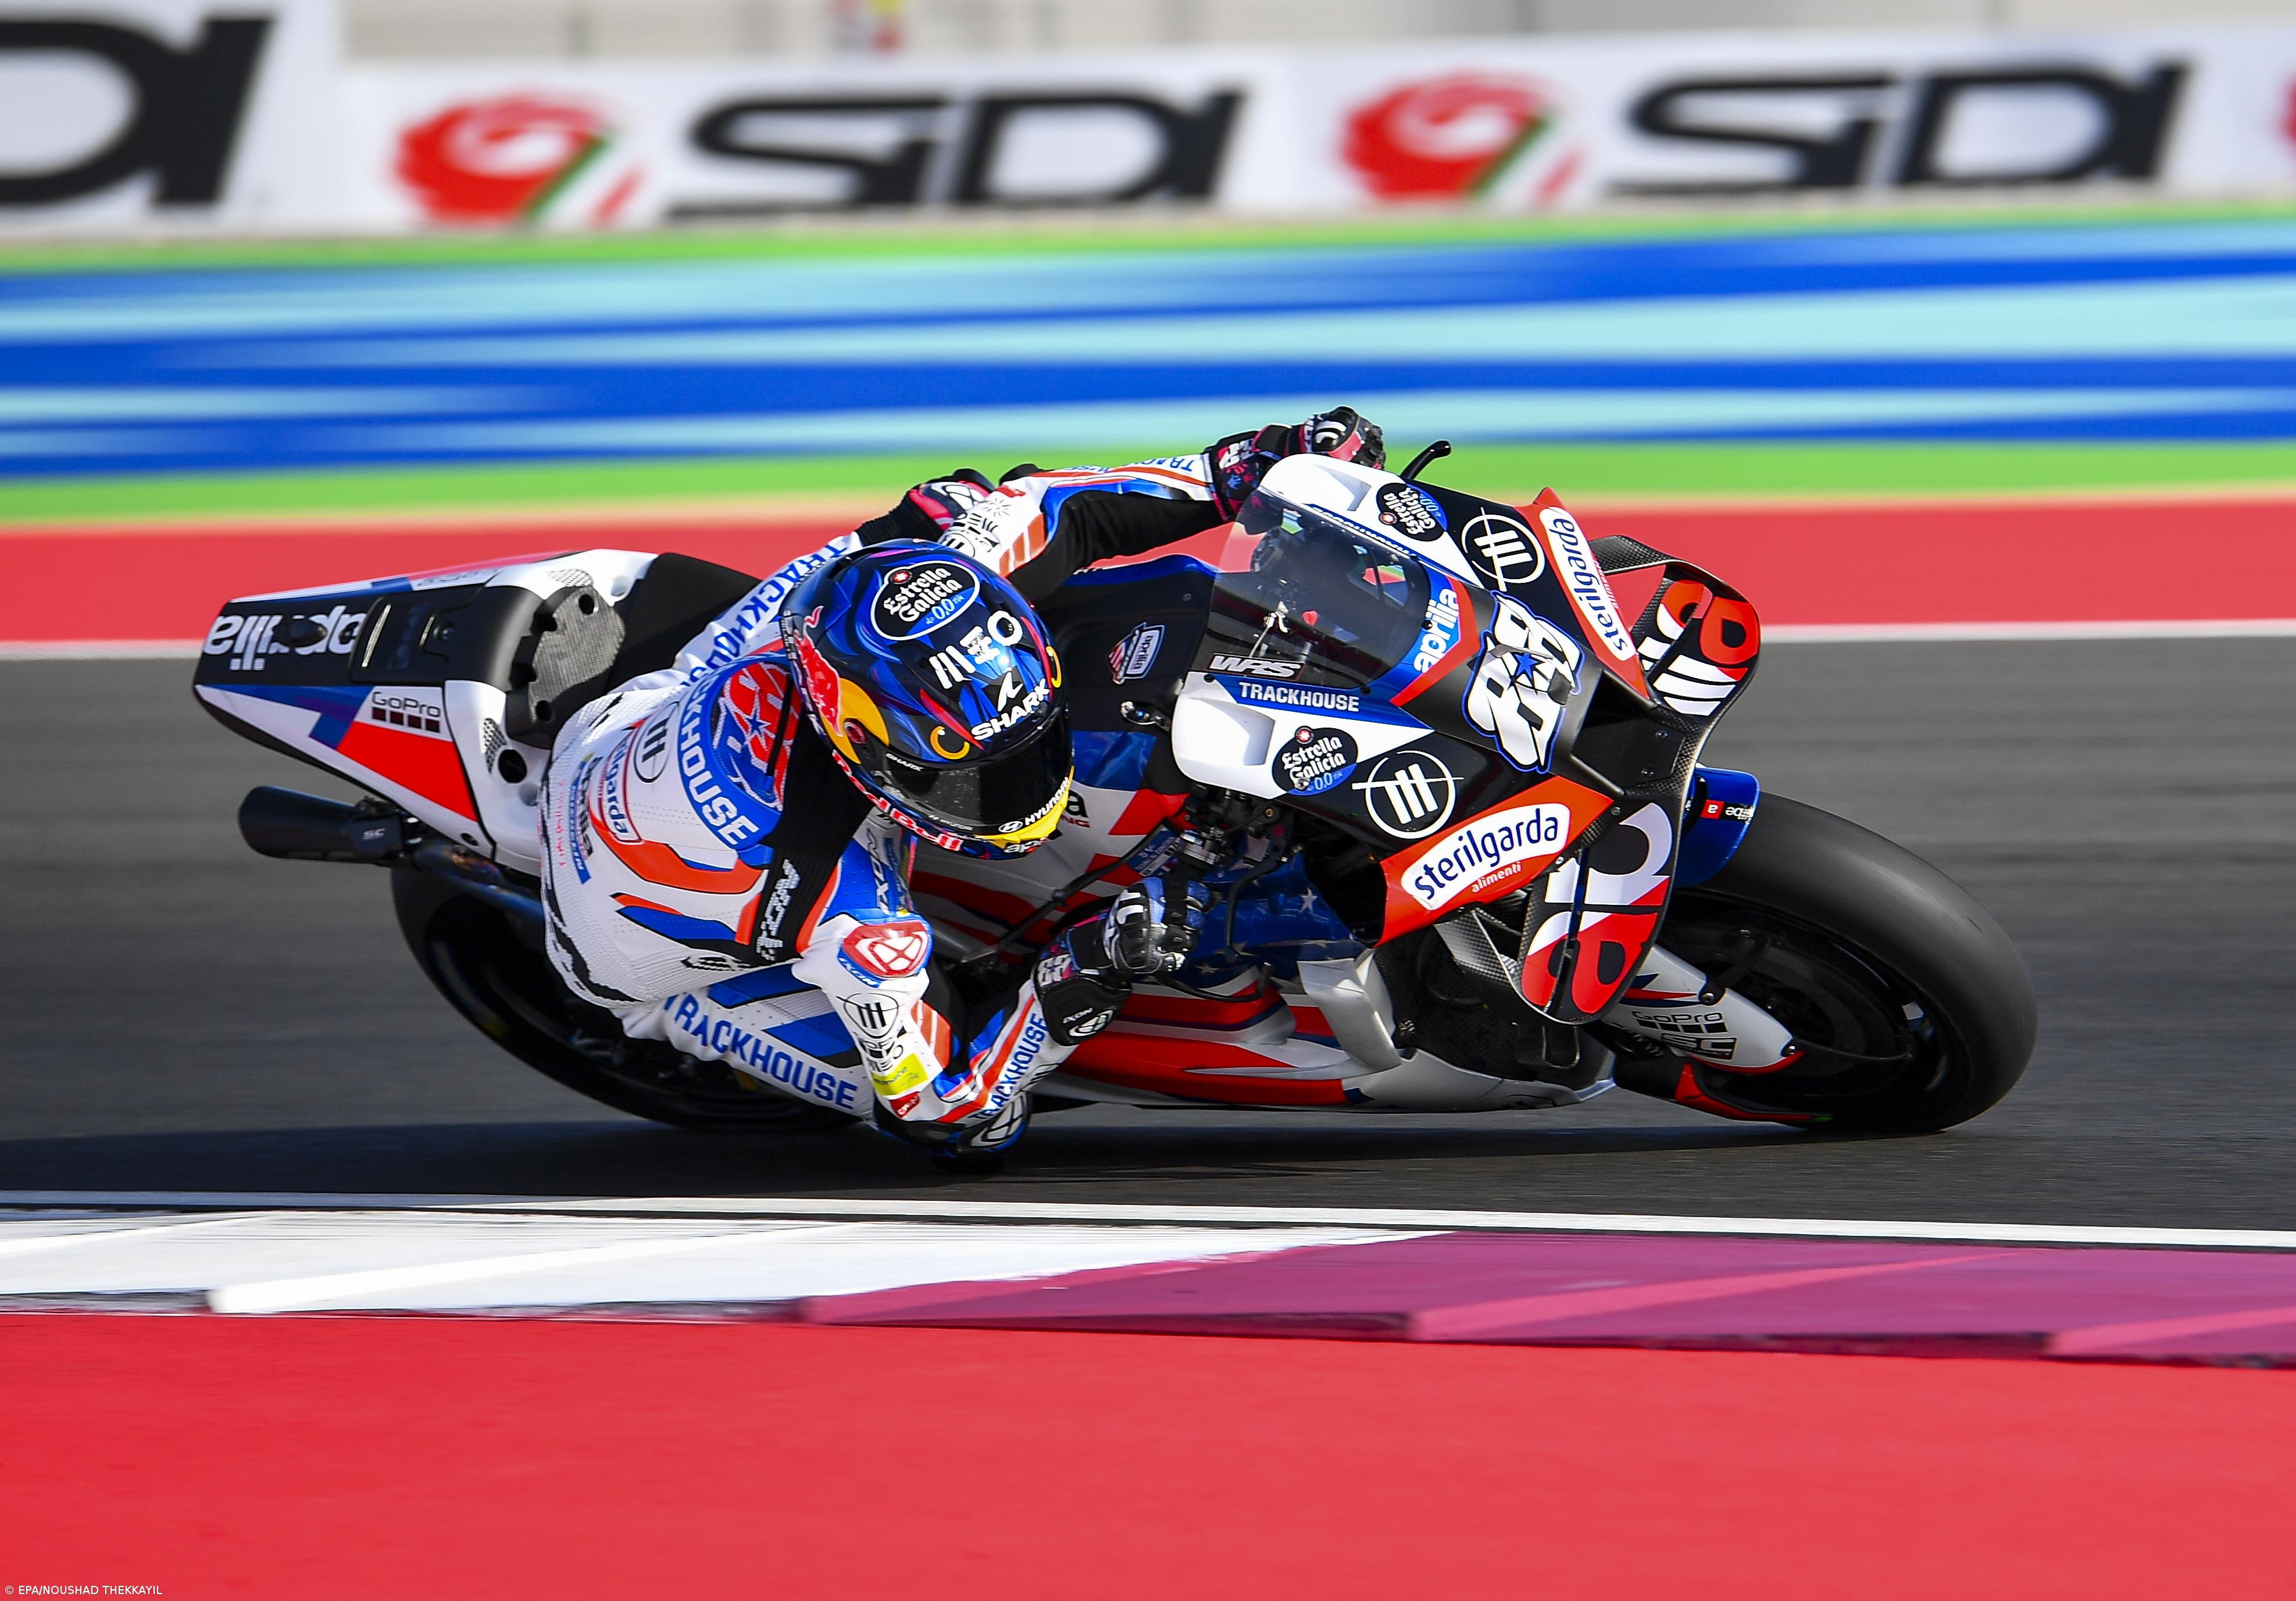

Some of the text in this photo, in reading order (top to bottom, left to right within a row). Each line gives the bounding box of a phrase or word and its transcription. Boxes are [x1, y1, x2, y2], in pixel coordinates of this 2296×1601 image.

[1606, 59, 2191, 195] SIDI
[665, 87, 1249, 216] SIDI
[1384, 493, 1425, 534] Estrella
[883, 566, 952, 615] Estrella
[898, 579, 963, 622] Galicia
[1549, 518, 1628, 652] sterilgarda
[1413, 587, 1459, 673] aprilia
[1209, 655, 1302, 678] WRS
[371, 691, 442, 719] GoPro
[971, 678, 1050, 741] SHARK
[1239, 682, 1359, 712] TRACKHOUSE
[886, 753, 924, 772] SHARK
[1281, 736, 1344, 770] Estrella
[1289, 753, 1347, 786] Galicia
[890, 808, 963, 853] Bull
[1414, 808, 1559, 901] sterilgarda
[1471, 861, 1522, 894] alimenti
